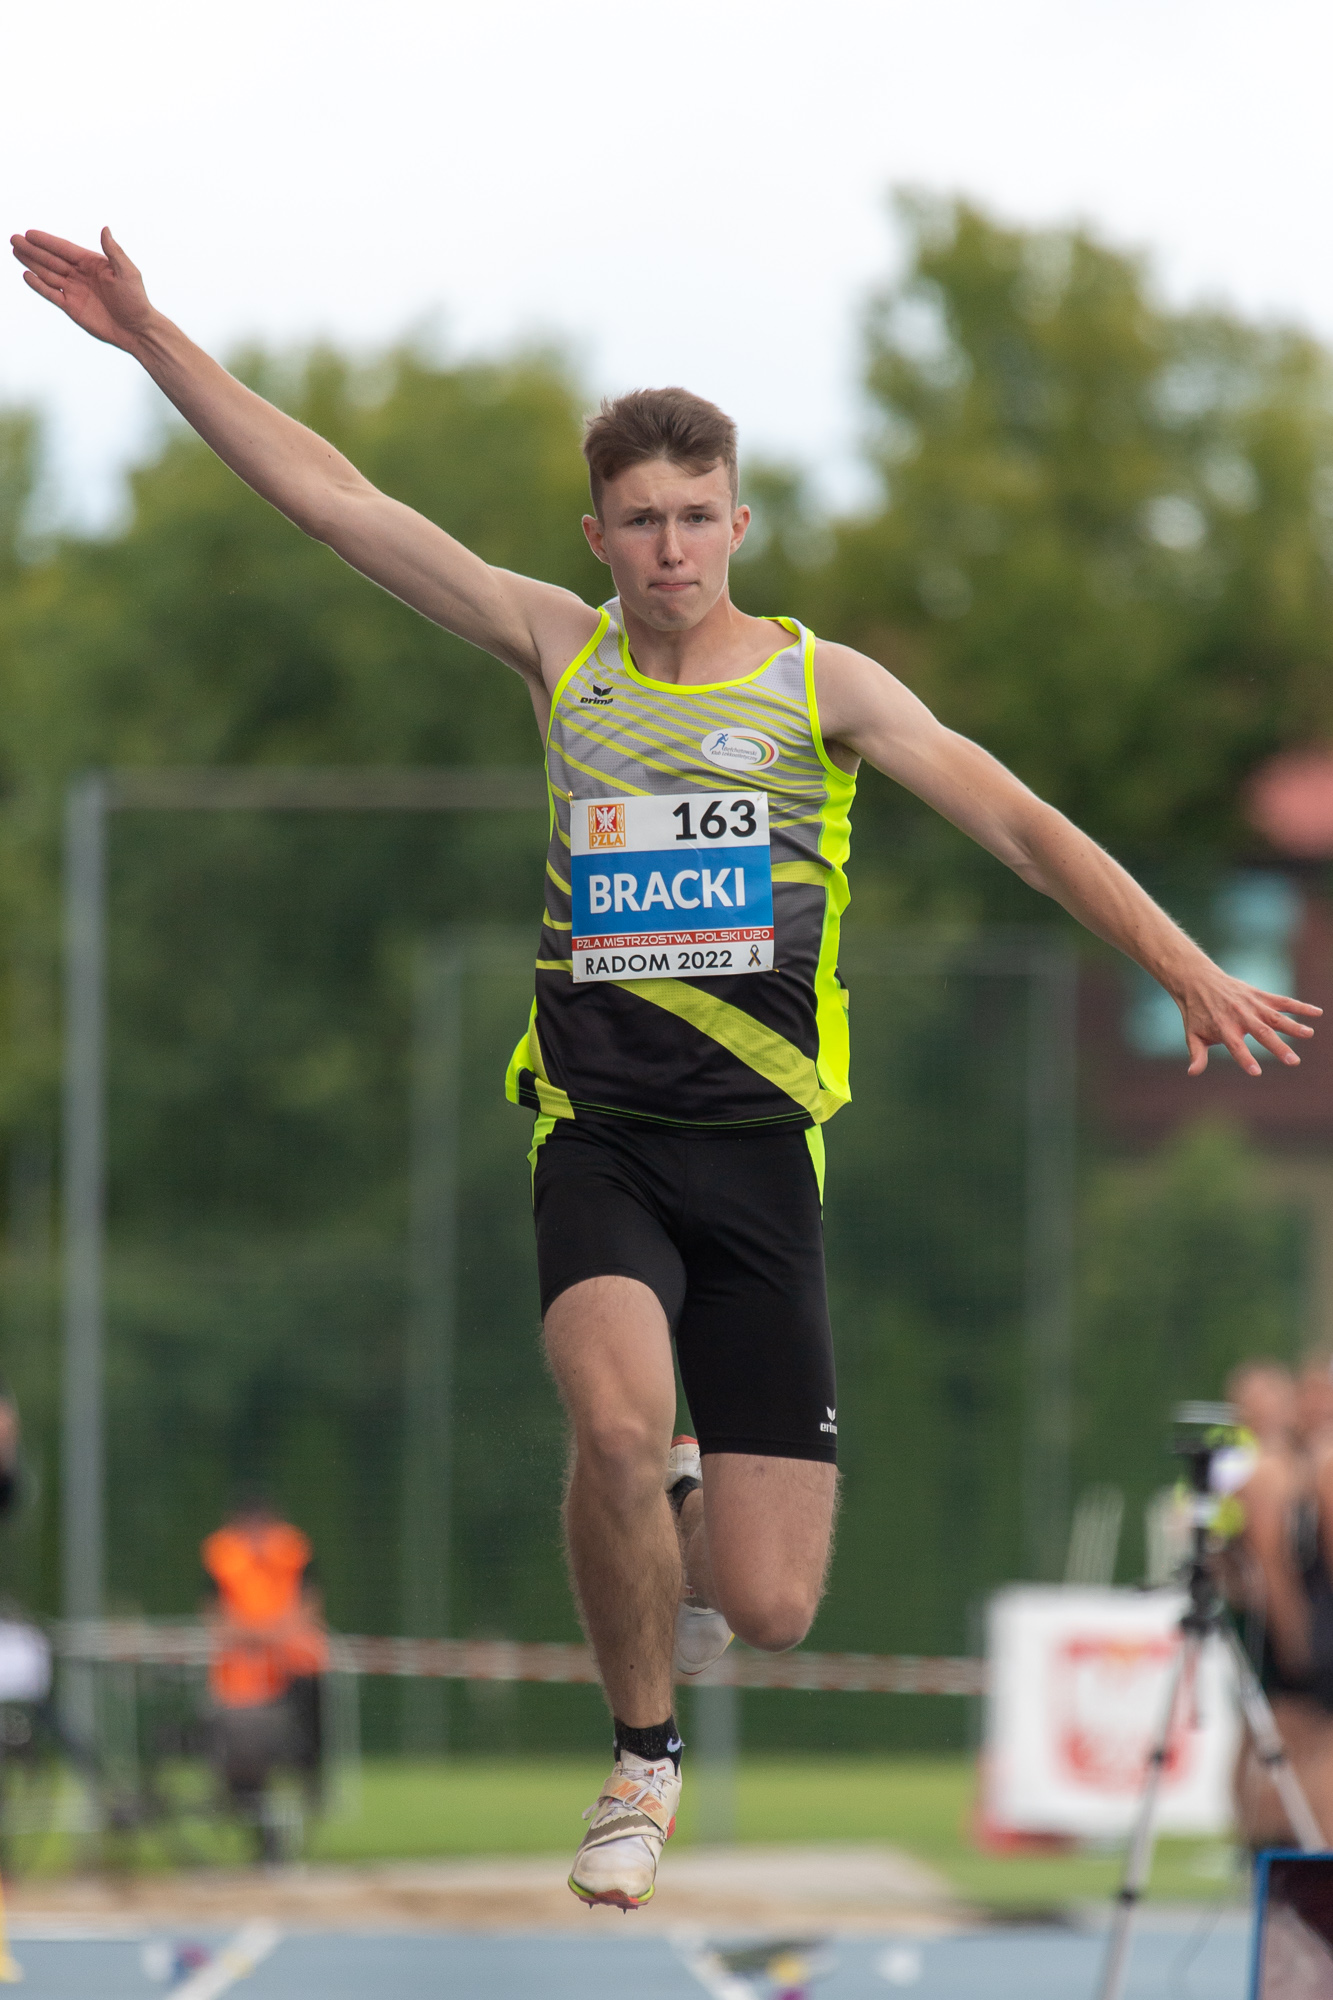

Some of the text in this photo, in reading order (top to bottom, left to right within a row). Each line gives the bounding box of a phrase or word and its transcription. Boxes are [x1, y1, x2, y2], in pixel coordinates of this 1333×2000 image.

[580, 697, 613, 705] erima
[672, 799, 757, 841] 163
[591, 833, 623, 848] PZLA
[589, 867, 746, 914] BRACKI
[576, 929, 770, 949] PZLA MISTRZOSTWA POLSKI U20
[585, 949, 733, 975] RADOM 2022
